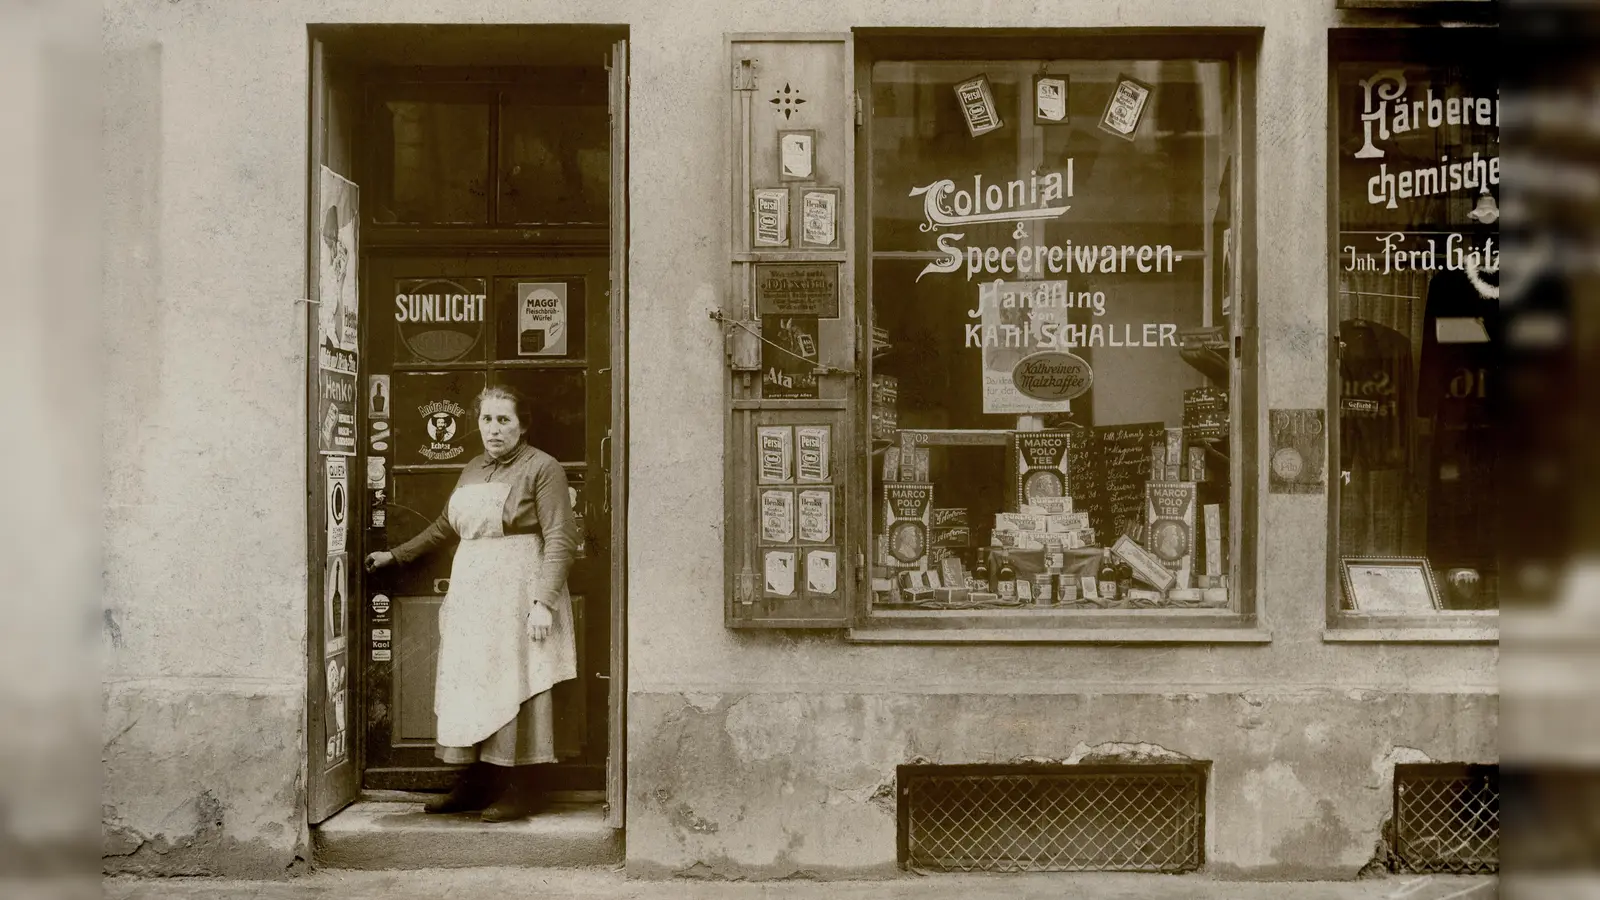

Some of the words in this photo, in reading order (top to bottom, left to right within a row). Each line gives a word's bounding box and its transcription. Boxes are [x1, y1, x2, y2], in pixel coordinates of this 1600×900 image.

[962, 88, 981, 104] Persil
[1367, 152, 1499, 209] chemische
[908, 157, 1075, 233] Colonial
[759, 198, 778, 211] Persil
[1012, 222, 1029, 240] &
[916, 232, 1182, 283] Specereiwaren-
[1344, 245, 1380, 272] Inh.
[1376, 231, 1444, 276] Ferd.
[967, 278, 1106, 318] Handlung
[394, 293, 487, 322] SUNLICHT
[1027, 311, 1055, 321] von
[1020, 359, 1082, 375] Kathreiners
[768, 366, 792, 389] Ata
[1020, 374, 1085, 394] Malzkaffee
[325, 375, 353, 402] Henko
[763, 436, 782, 449] Persil
[801, 436, 820, 449] Persil
[1024, 439, 1062, 447] MARCO
[1030, 448, 1057, 456] POLO
[1032, 456, 1053, 464] TEE
[892, 490, 926, 498] MARCO
[1153, 489, 1187, 498] MARCO
[897, 499, 921, 507] POLO
[1158, 498, 1182, 506] POLO
[899, 508, 917, 516] TEE
[1160, 507, 1178, 515] TEE
[372, 640, 390, 648] Kaol
